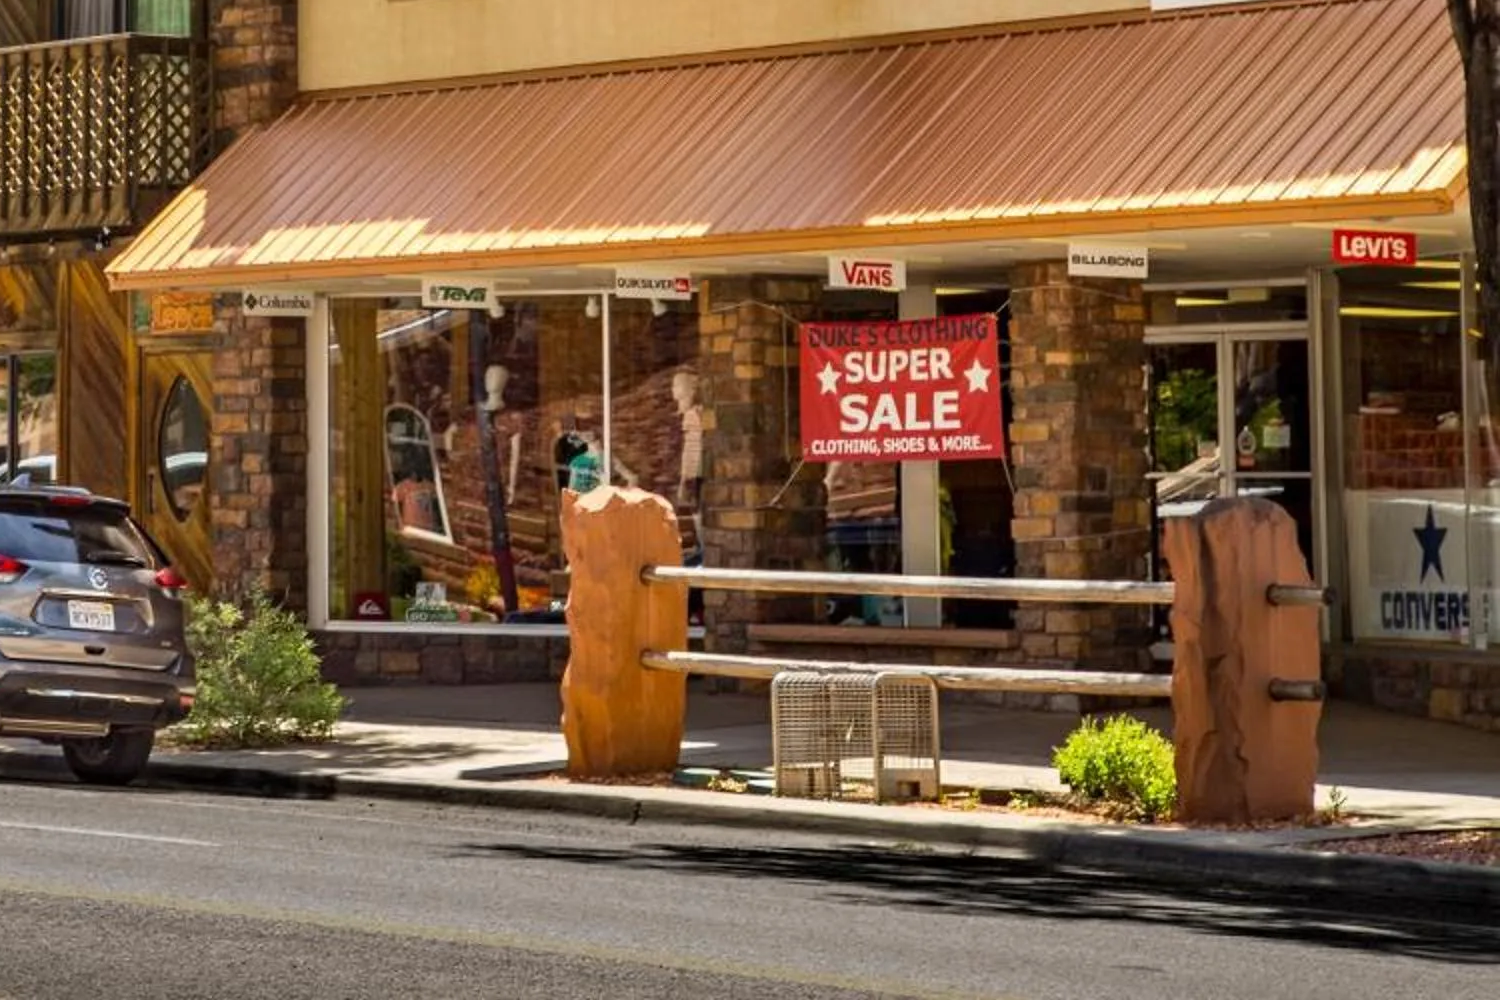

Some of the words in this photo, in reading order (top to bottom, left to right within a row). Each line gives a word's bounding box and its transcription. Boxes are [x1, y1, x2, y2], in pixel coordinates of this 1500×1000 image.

[1071, 254, 1145, 266] BILLABONG
[617, 278, 674, 289] QUIKSILVER
[842, 261, 892, 287] VANS
[259, 295, 310, 309] Columbia
[884, 318, 988, 345] CLOTHING
[844, 347, 954, 384] SUPER
[840, 390, 962, 433] SALE
[812, 438, 881, 456] CLOTHING,
[884, 437, 925, 452] SHOES
[927, 437, 940, 451] &
[1381, 591, 1489, 632] CONVERS
